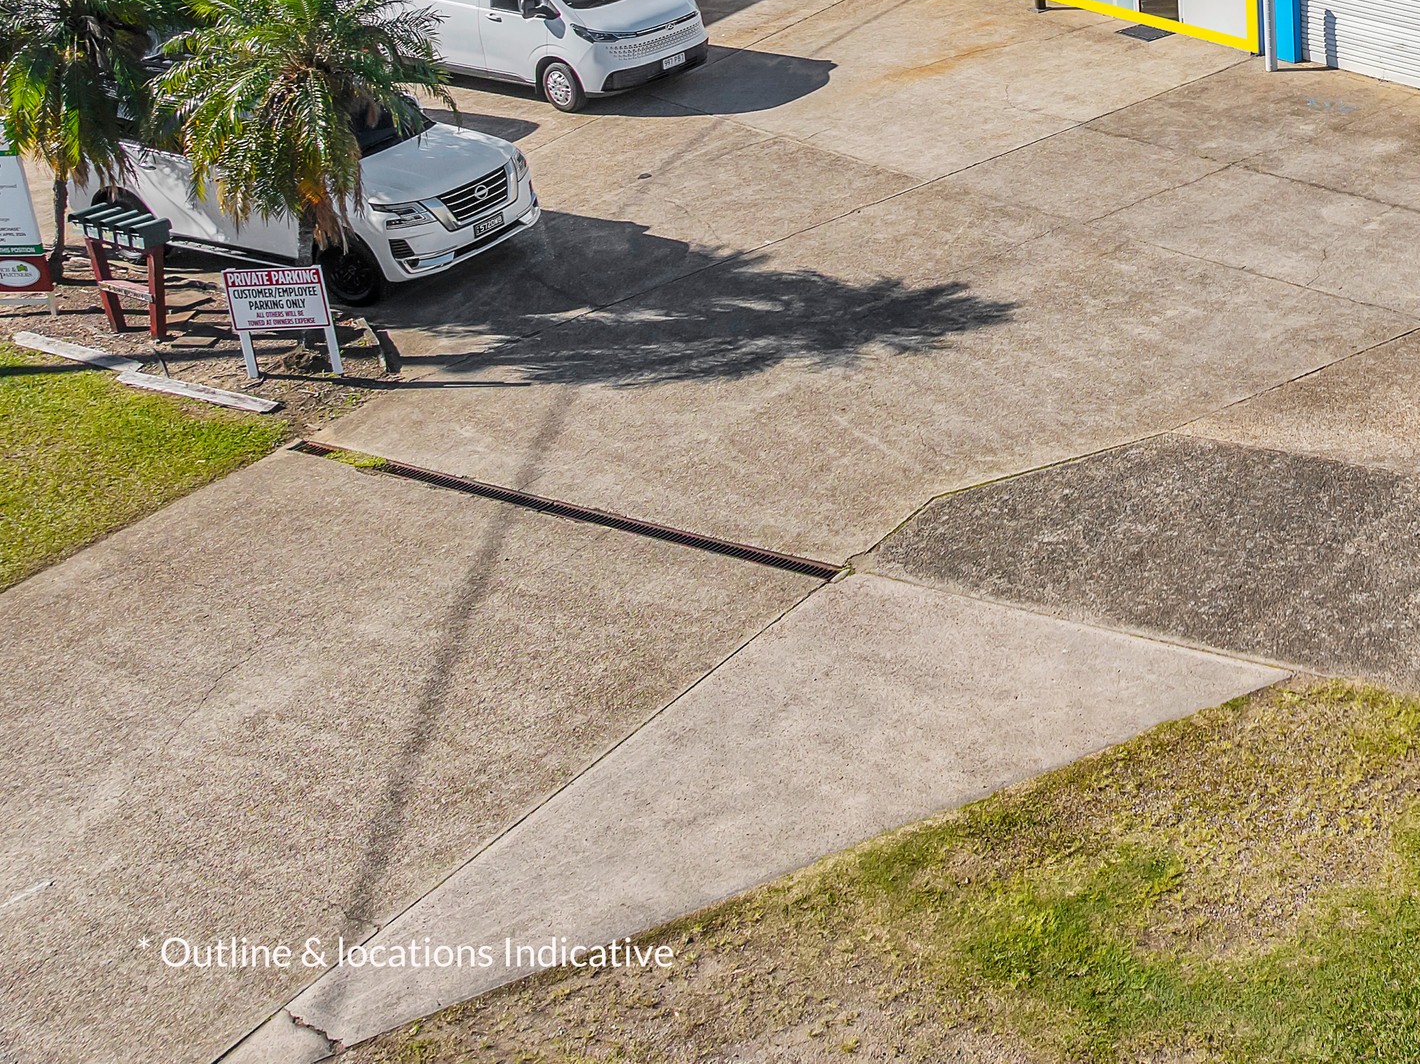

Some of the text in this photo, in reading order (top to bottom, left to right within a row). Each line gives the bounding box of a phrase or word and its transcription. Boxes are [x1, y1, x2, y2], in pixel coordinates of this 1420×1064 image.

[226, 269, 319, 286] PRIVATE PARKING
[232, 286, 318, 300] CUSTOMER/EMPLOYEE
[248, 298, 306, 311] PARKING ONLY
[247, 319, 265, 327] TOWED
